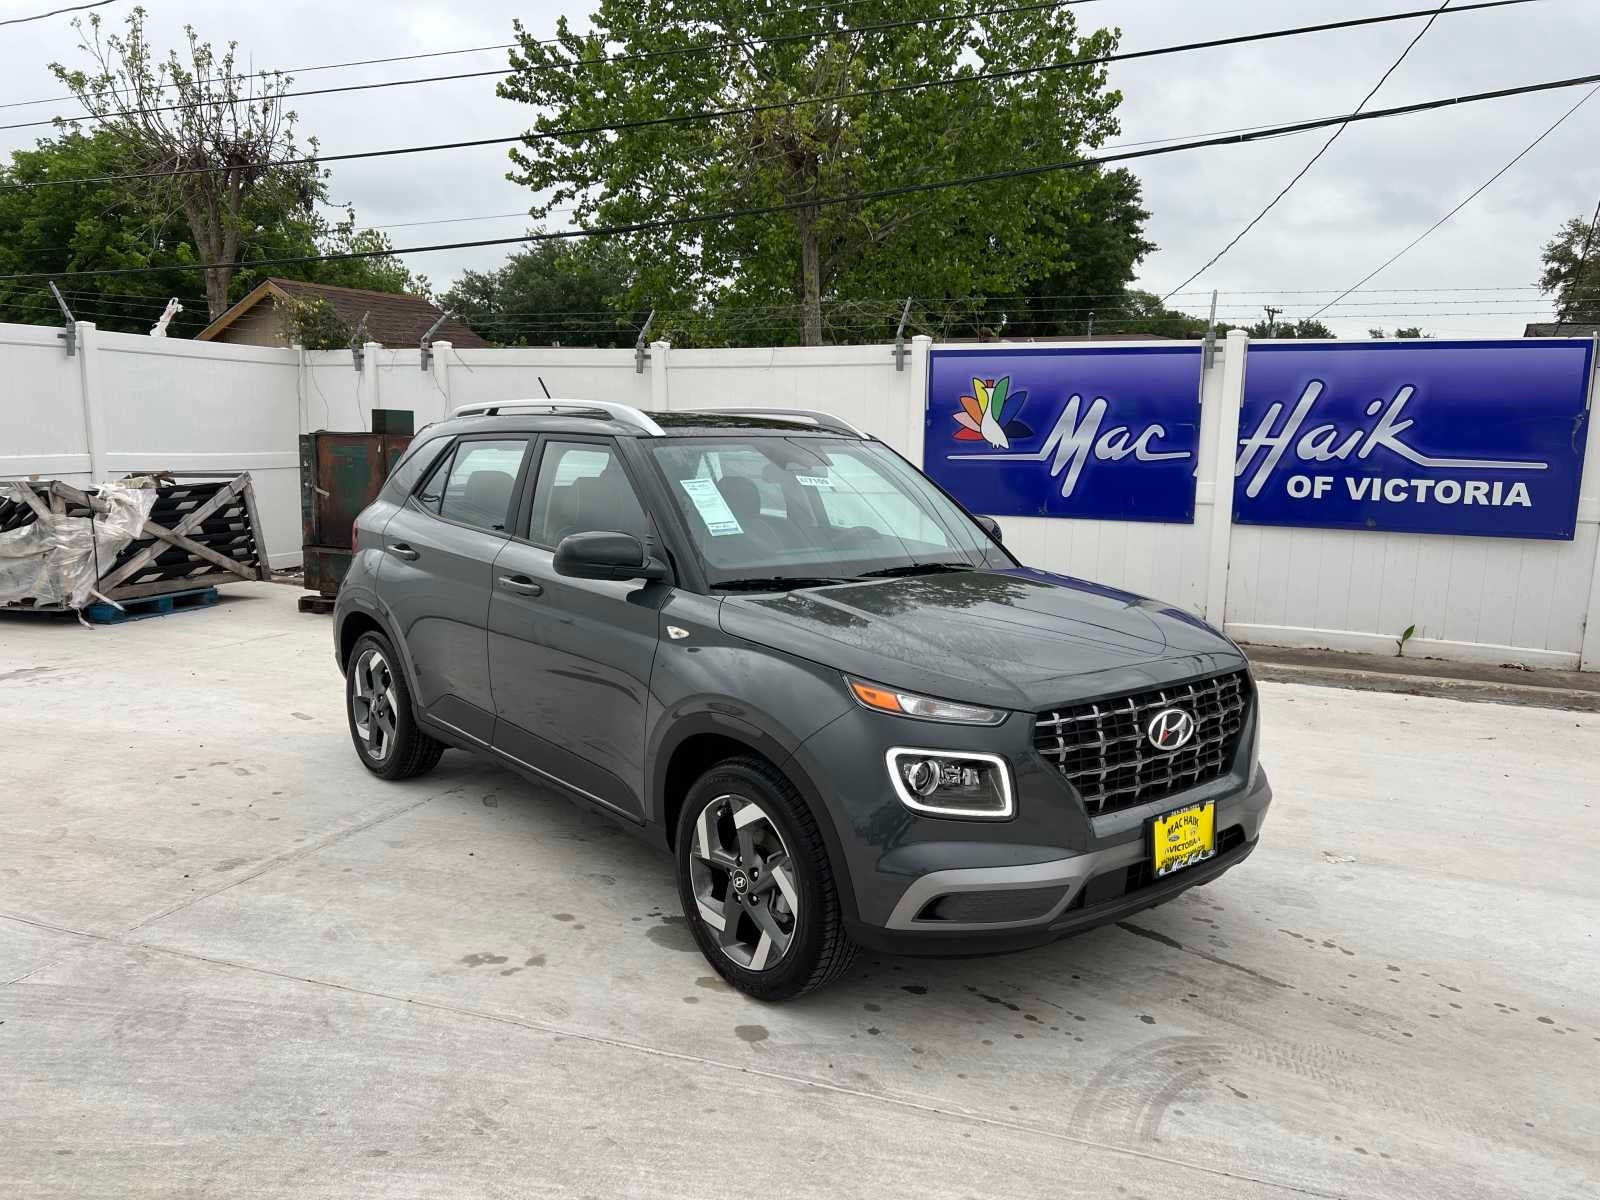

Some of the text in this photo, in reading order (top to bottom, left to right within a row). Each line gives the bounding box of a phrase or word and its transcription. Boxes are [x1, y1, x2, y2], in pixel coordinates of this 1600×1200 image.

[1037, 378, 1548, 498] Mac Haik
[1286, 474, 1532, 507] OF VICTORIA
[1167, 818, 1183, 835] MAC
